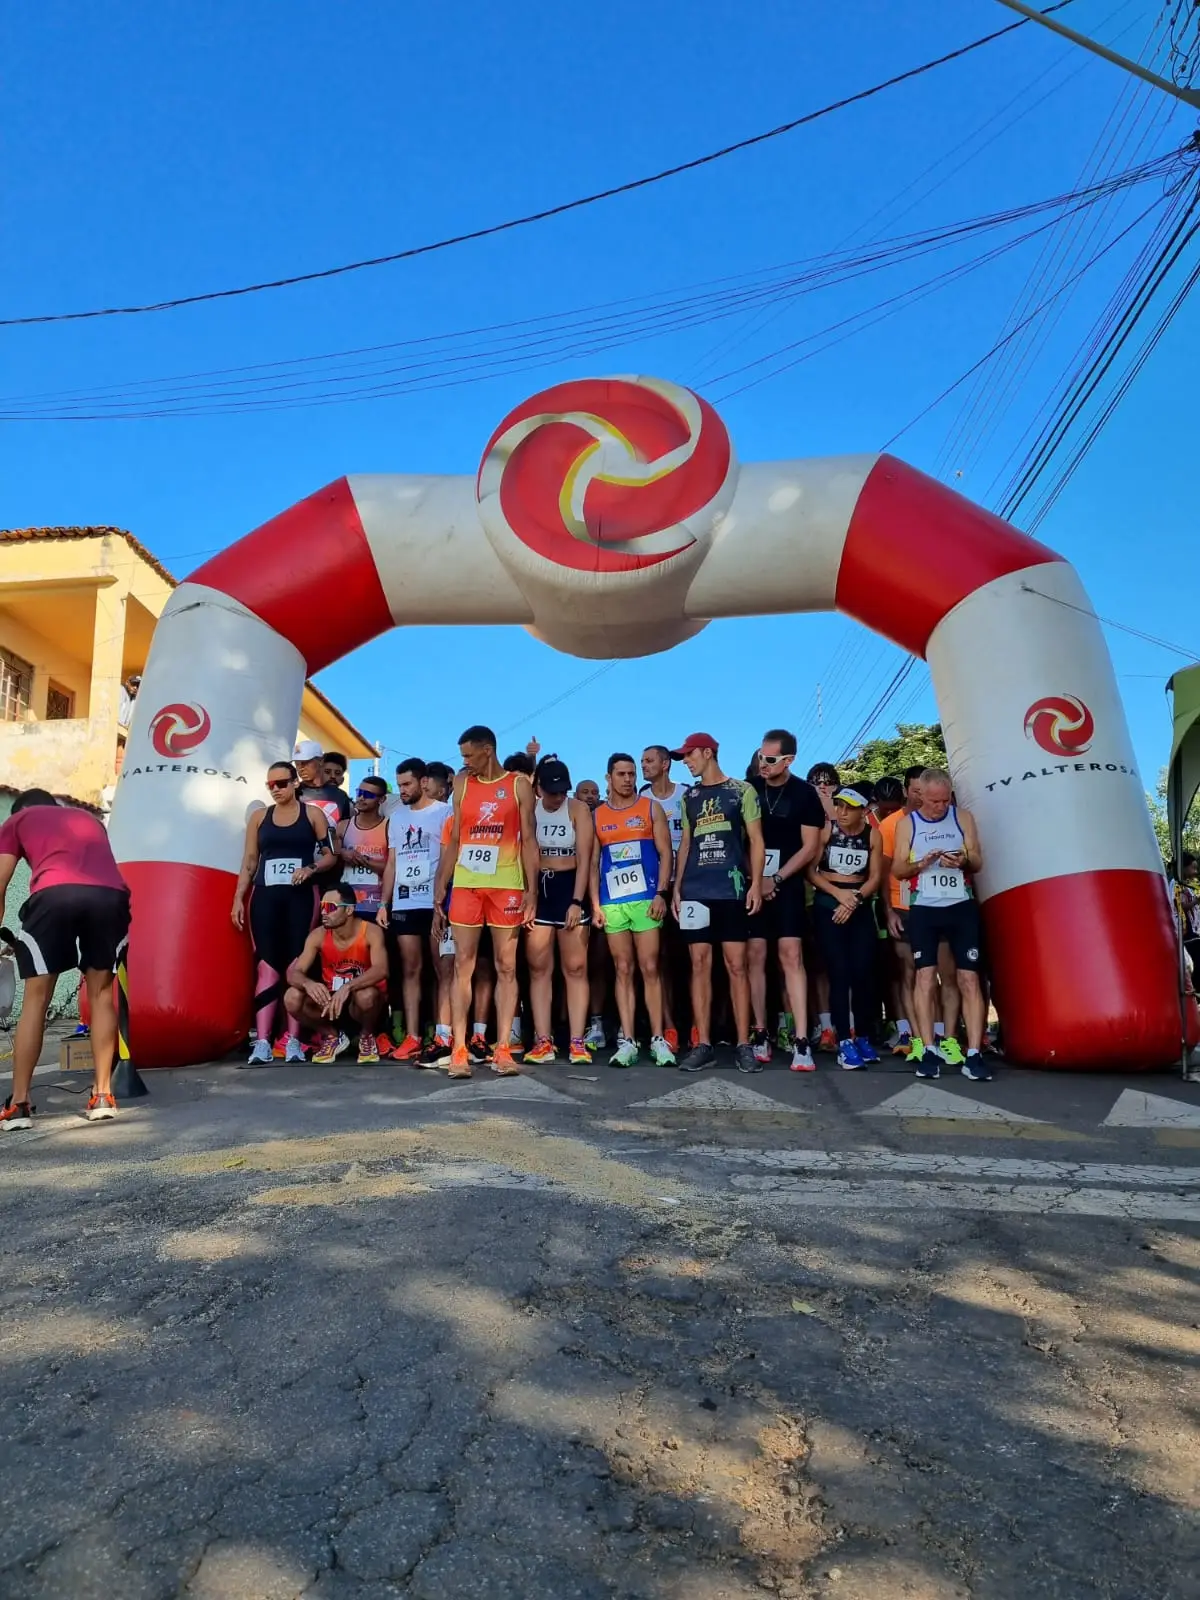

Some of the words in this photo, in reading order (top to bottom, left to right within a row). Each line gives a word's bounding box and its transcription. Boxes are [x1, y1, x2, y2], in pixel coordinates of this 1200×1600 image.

[132, 764, 248, 784] ALTEROSA
[985, 776, 1013, 792] TV
[1022, 762, 1139, 781] ALTEROSA
[543, 825, 566, 837] 173
[468, 849, 492, 862] 198
[838, 853, 862, 866] 105
[272, 863, 296, 875] 125
[406, 866, 421, 878] 26
[613, 870, 639, 887] 106
[931, 875, 958, 888] 108
[687, 906, 695, 919] 2
